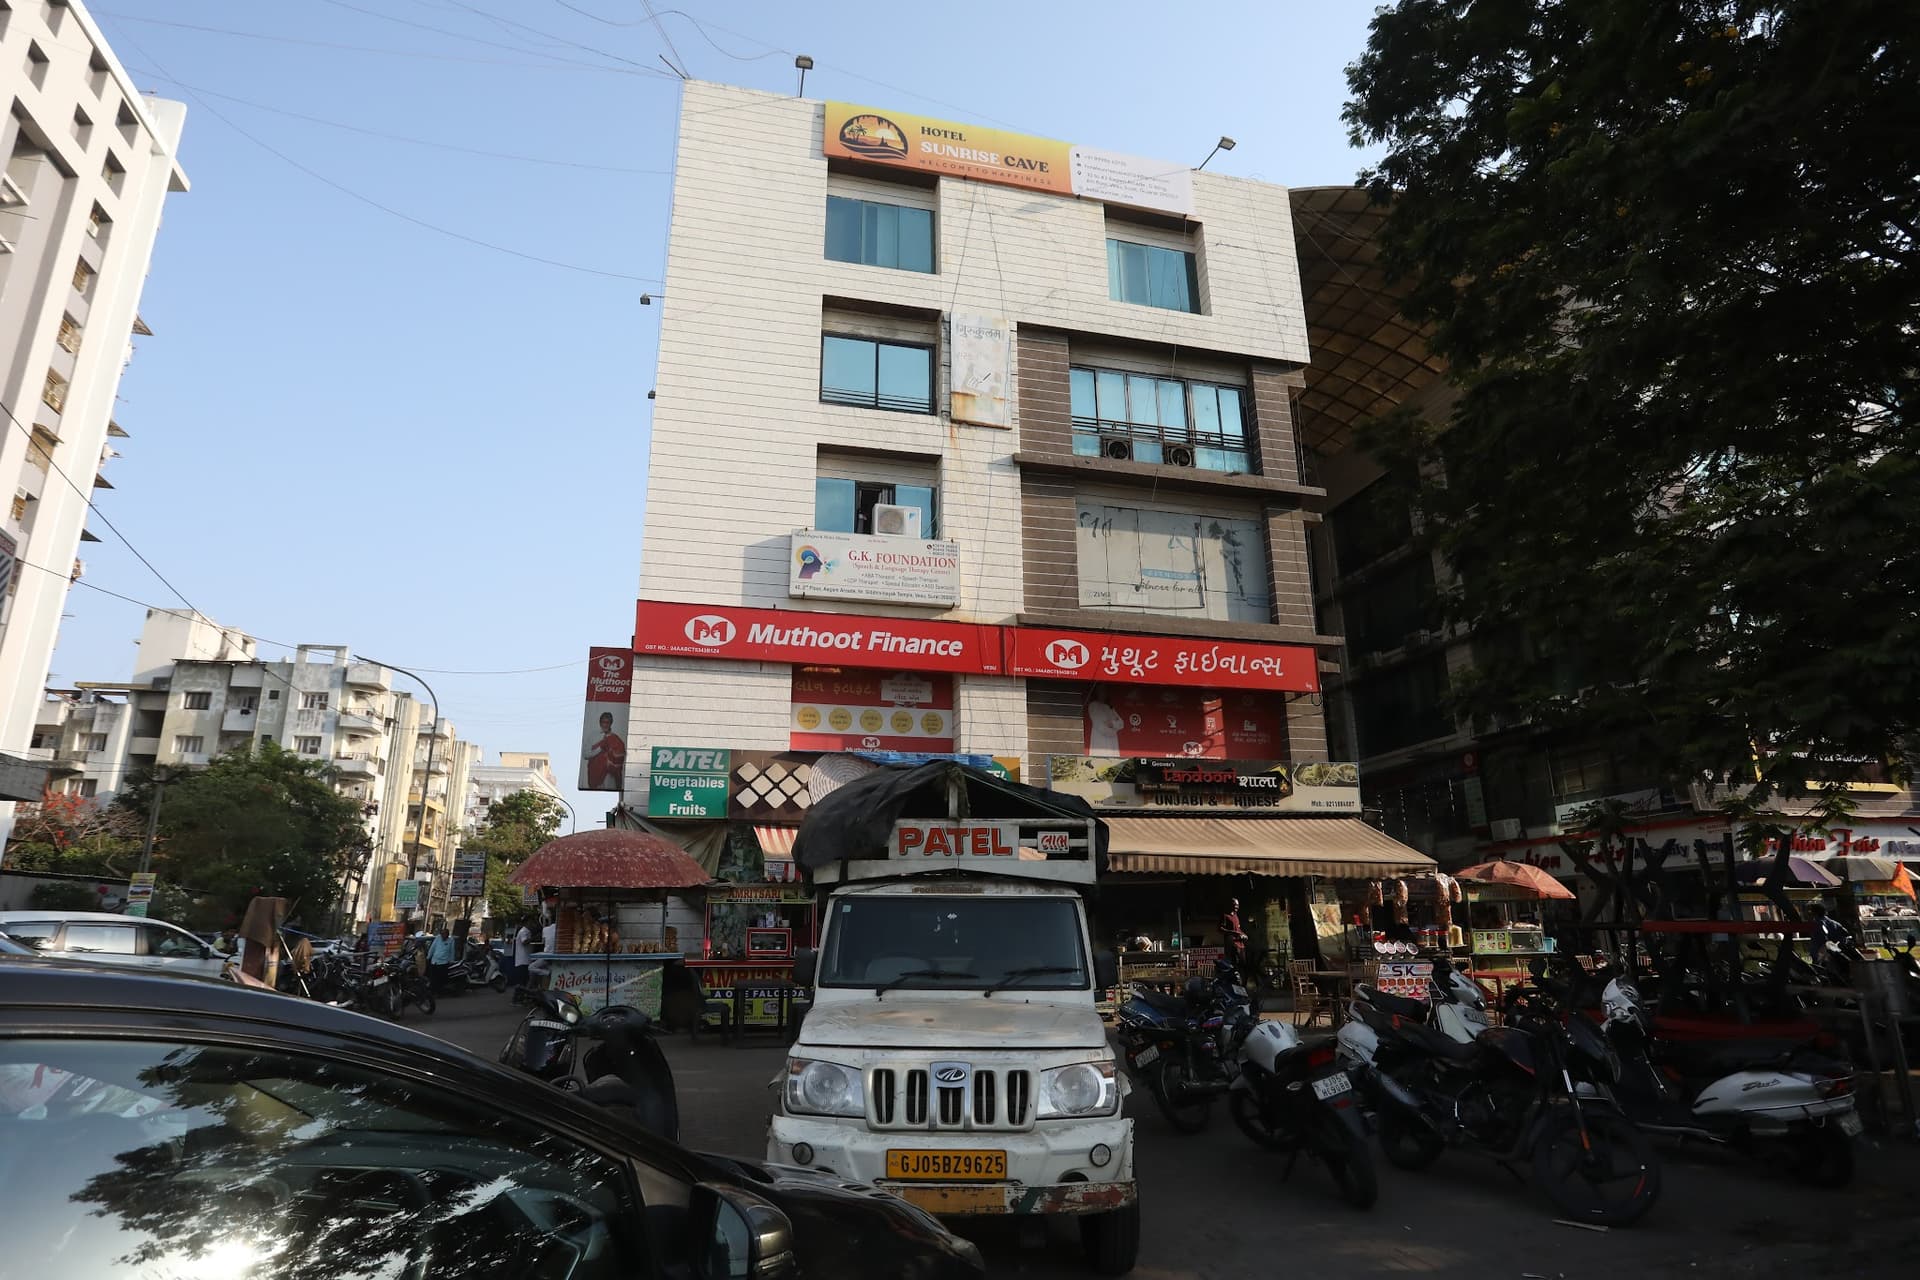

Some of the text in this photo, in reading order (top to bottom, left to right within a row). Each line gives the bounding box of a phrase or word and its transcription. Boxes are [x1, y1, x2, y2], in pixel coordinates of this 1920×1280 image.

[921, 126, 966, 142] HOTEL
[920, 141, 1049, 173] SUNRISE CAVE
[848, 550, 956, 568] G.K. FOUNDATION
[746, 623, 963, 657] Muthoot Finance
[1100, 646, 1284, 678] મુથૂટ ફાઈનાન્સ
[602, 670, 620, 678] The
[590, 676, 631, 687] Muthoot
[594, 684, 625, 694] Group
[655, 750, 725, 770] PATEL
[654, 775, 725, 789] Vegetables
[1237, 775, 1279, 789] शाला
[683, 790, 694, 801] &
[1207, 794, 1218, 806] &
[1223, 794, 1280, 808] HINESE
[669, 803, 706, 816] Fruits
[898, 826, 1013, 857] PATEL
[728, 886, 781, 898] AMRITSARI
[1391, 965, 1416, 976] SK
[901, 1155, 1004, 1174] GJ05BZ9625
